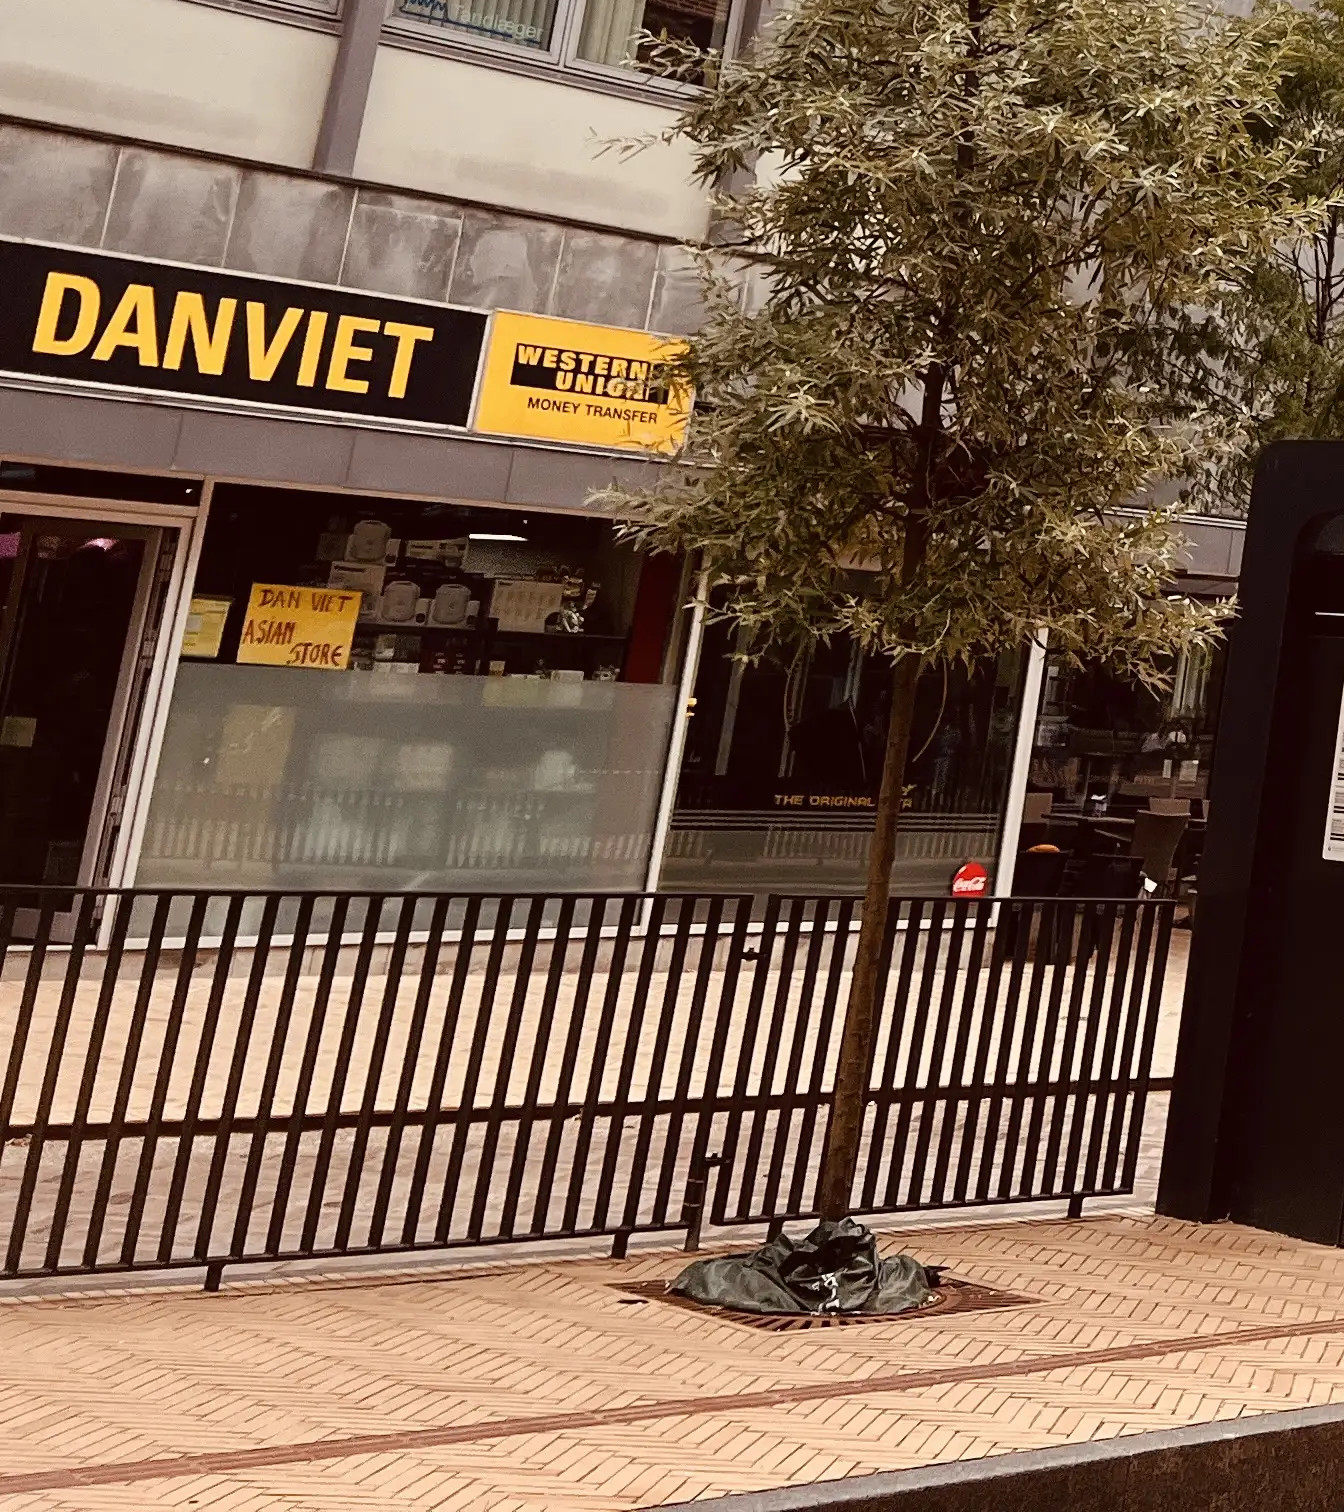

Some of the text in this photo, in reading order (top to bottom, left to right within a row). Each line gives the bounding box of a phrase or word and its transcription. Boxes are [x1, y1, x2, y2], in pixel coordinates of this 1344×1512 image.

[31, 271, 435, 399] DANVIET
[517, 344, 649, 380] WESTERN
[527, 396, 659, 425] MONEY TRANSFER
[258, 589, 354, 613] DAN VIET
[242, 616, 297, 646] ASIAN
[286, 642, 344, 667] STORE
[774, 794, 876, 809] THE ORIGINAL
